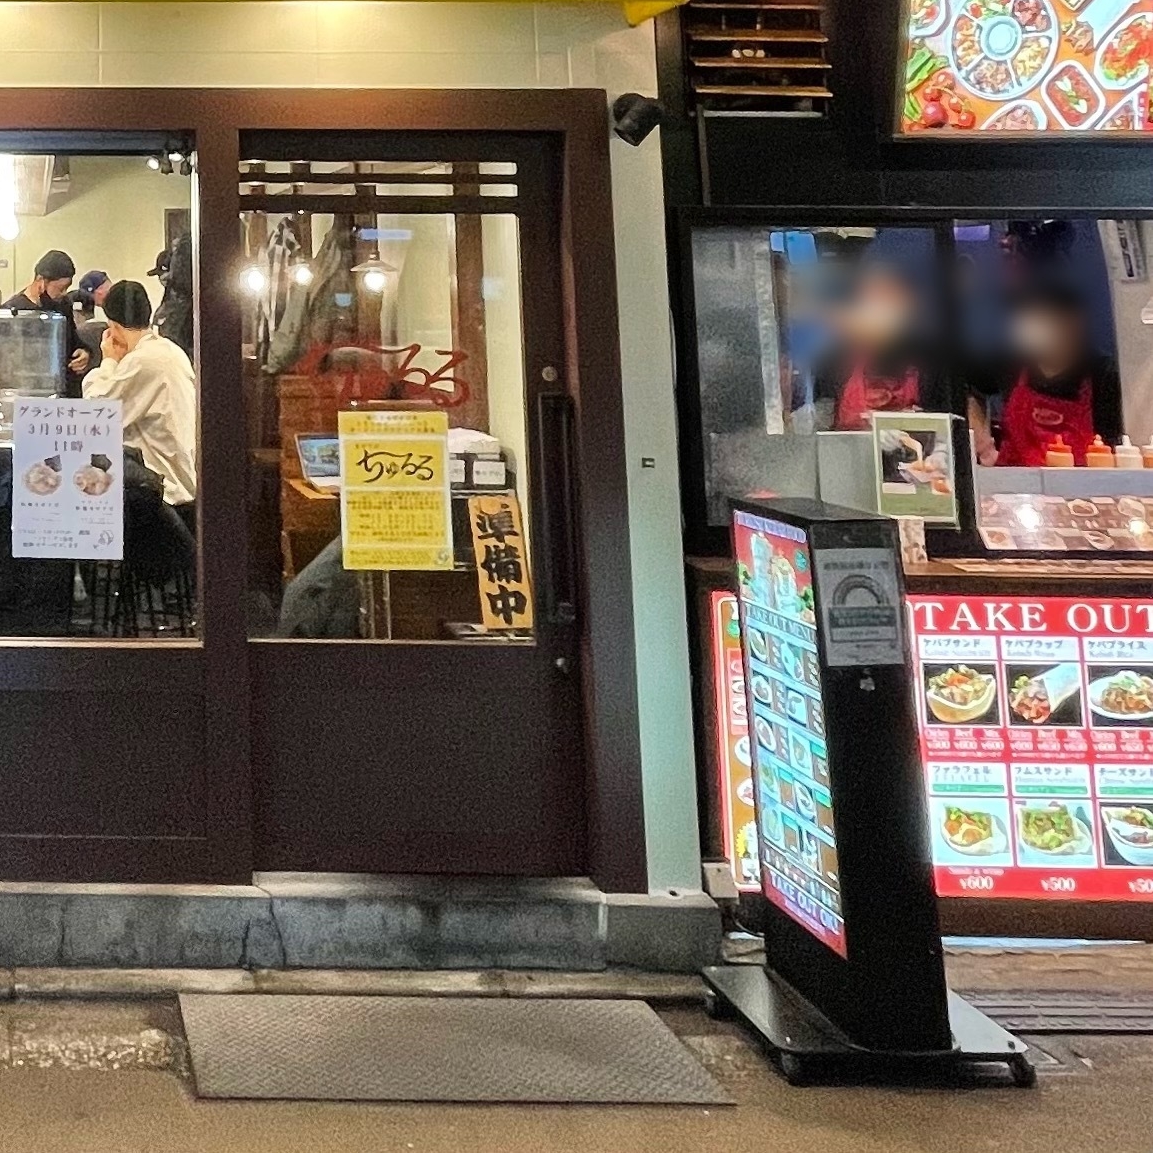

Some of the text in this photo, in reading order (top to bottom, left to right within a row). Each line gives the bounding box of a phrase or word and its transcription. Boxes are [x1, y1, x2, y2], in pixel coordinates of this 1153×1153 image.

[20, 406, 117, 419] グランドオープン
[356, 449, 434, 483] ちゅるる
[476, 503, 528, 625] 準備中
[914, 602, 1047, 632] TAKE
[1099, 768, 1153, 777] チーズサン
